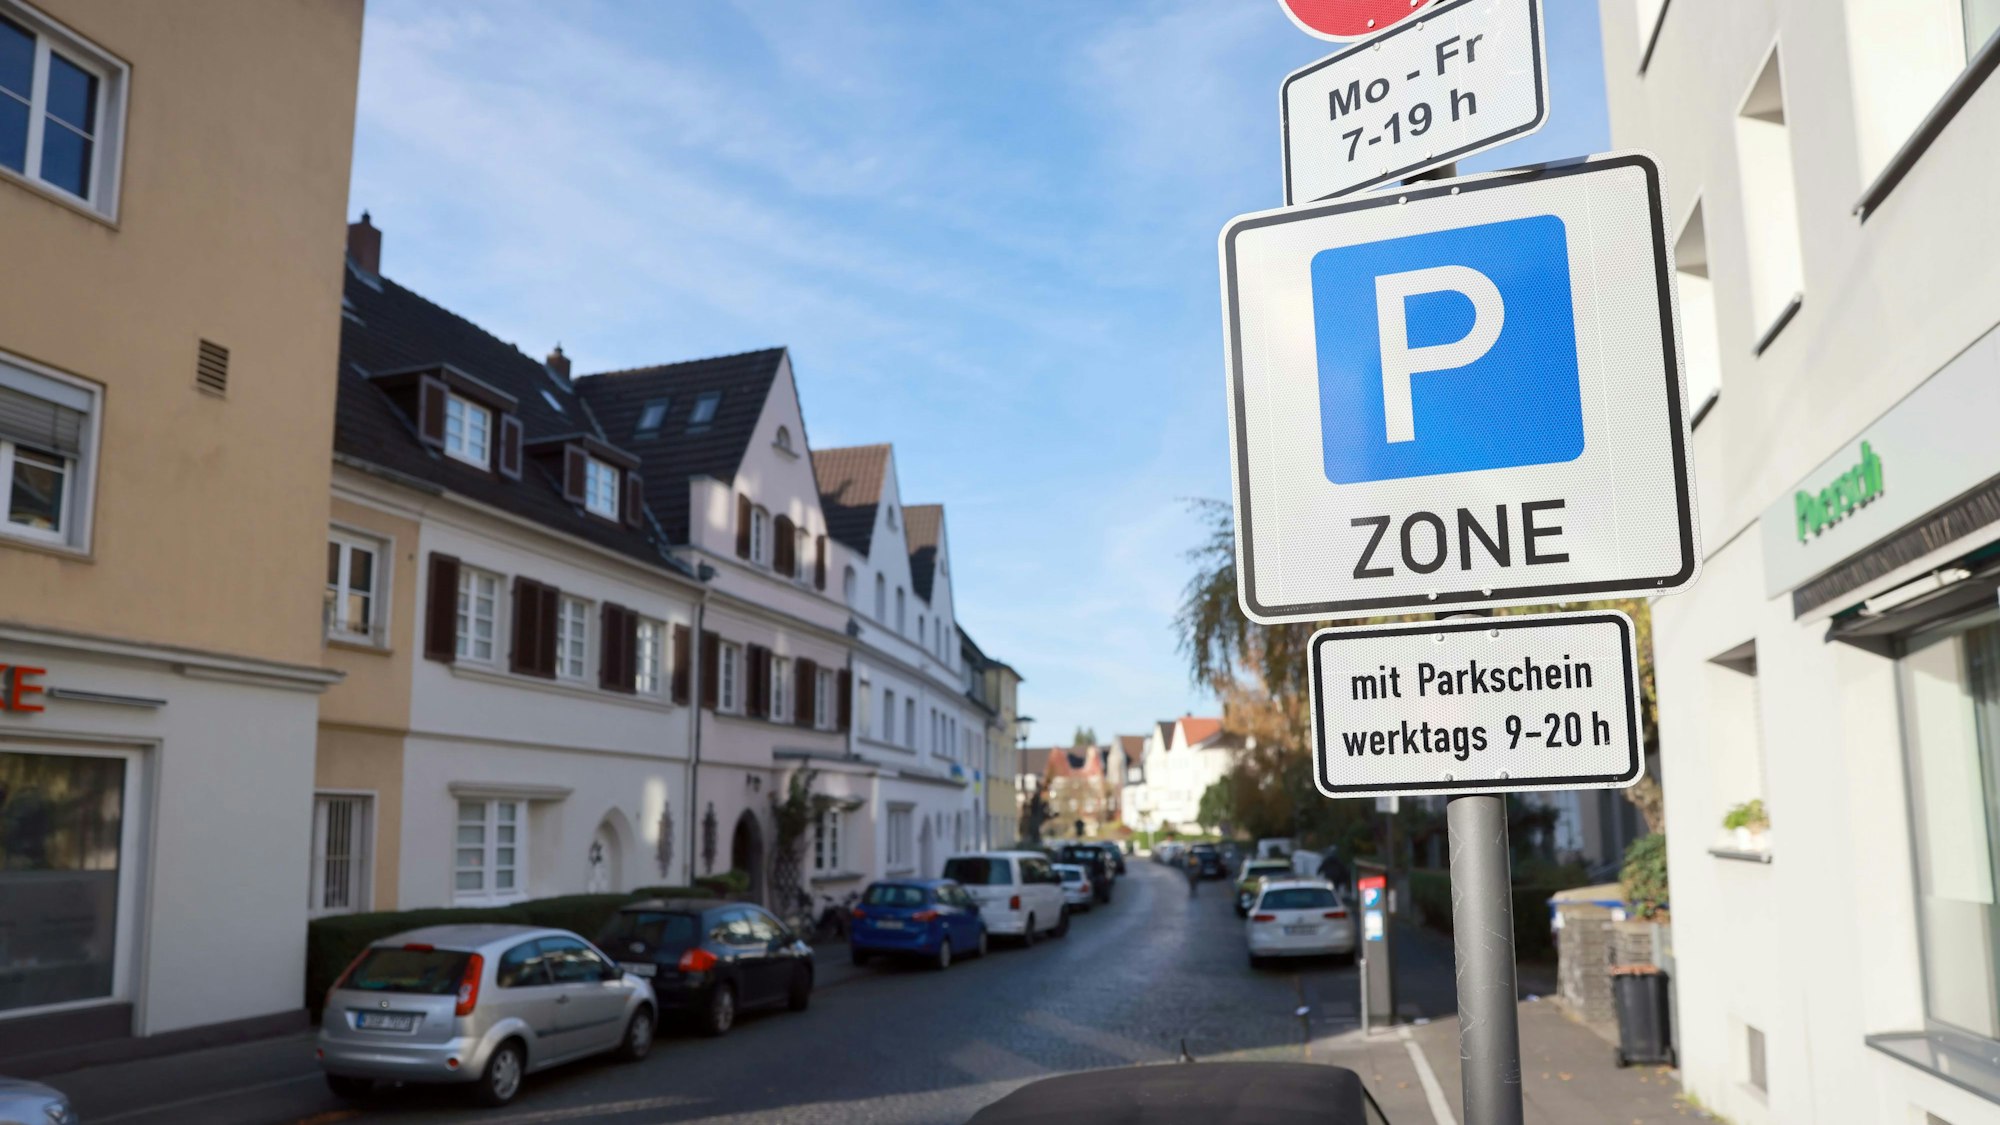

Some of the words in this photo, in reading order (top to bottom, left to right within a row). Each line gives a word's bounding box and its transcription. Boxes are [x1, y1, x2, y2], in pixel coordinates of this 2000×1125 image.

[1329, 77, 1390, 121] Mo
[1406, 70, 1420, 81] -
[1436, 34, 1484, 76] Fr
[1342, 102, 1432, 162] 7-19
[1450, 88, 1477, 122] h
[1374, 264, 1505, 444] P
[1350, 498, 1570, 580] ZONE
[1351, 665, 1402, 700] mit
[1418, 654, 1593, 697] Parkschein
[1342, 720, 1488, 762] werktags
[1591, 711, 1611, 747] h
